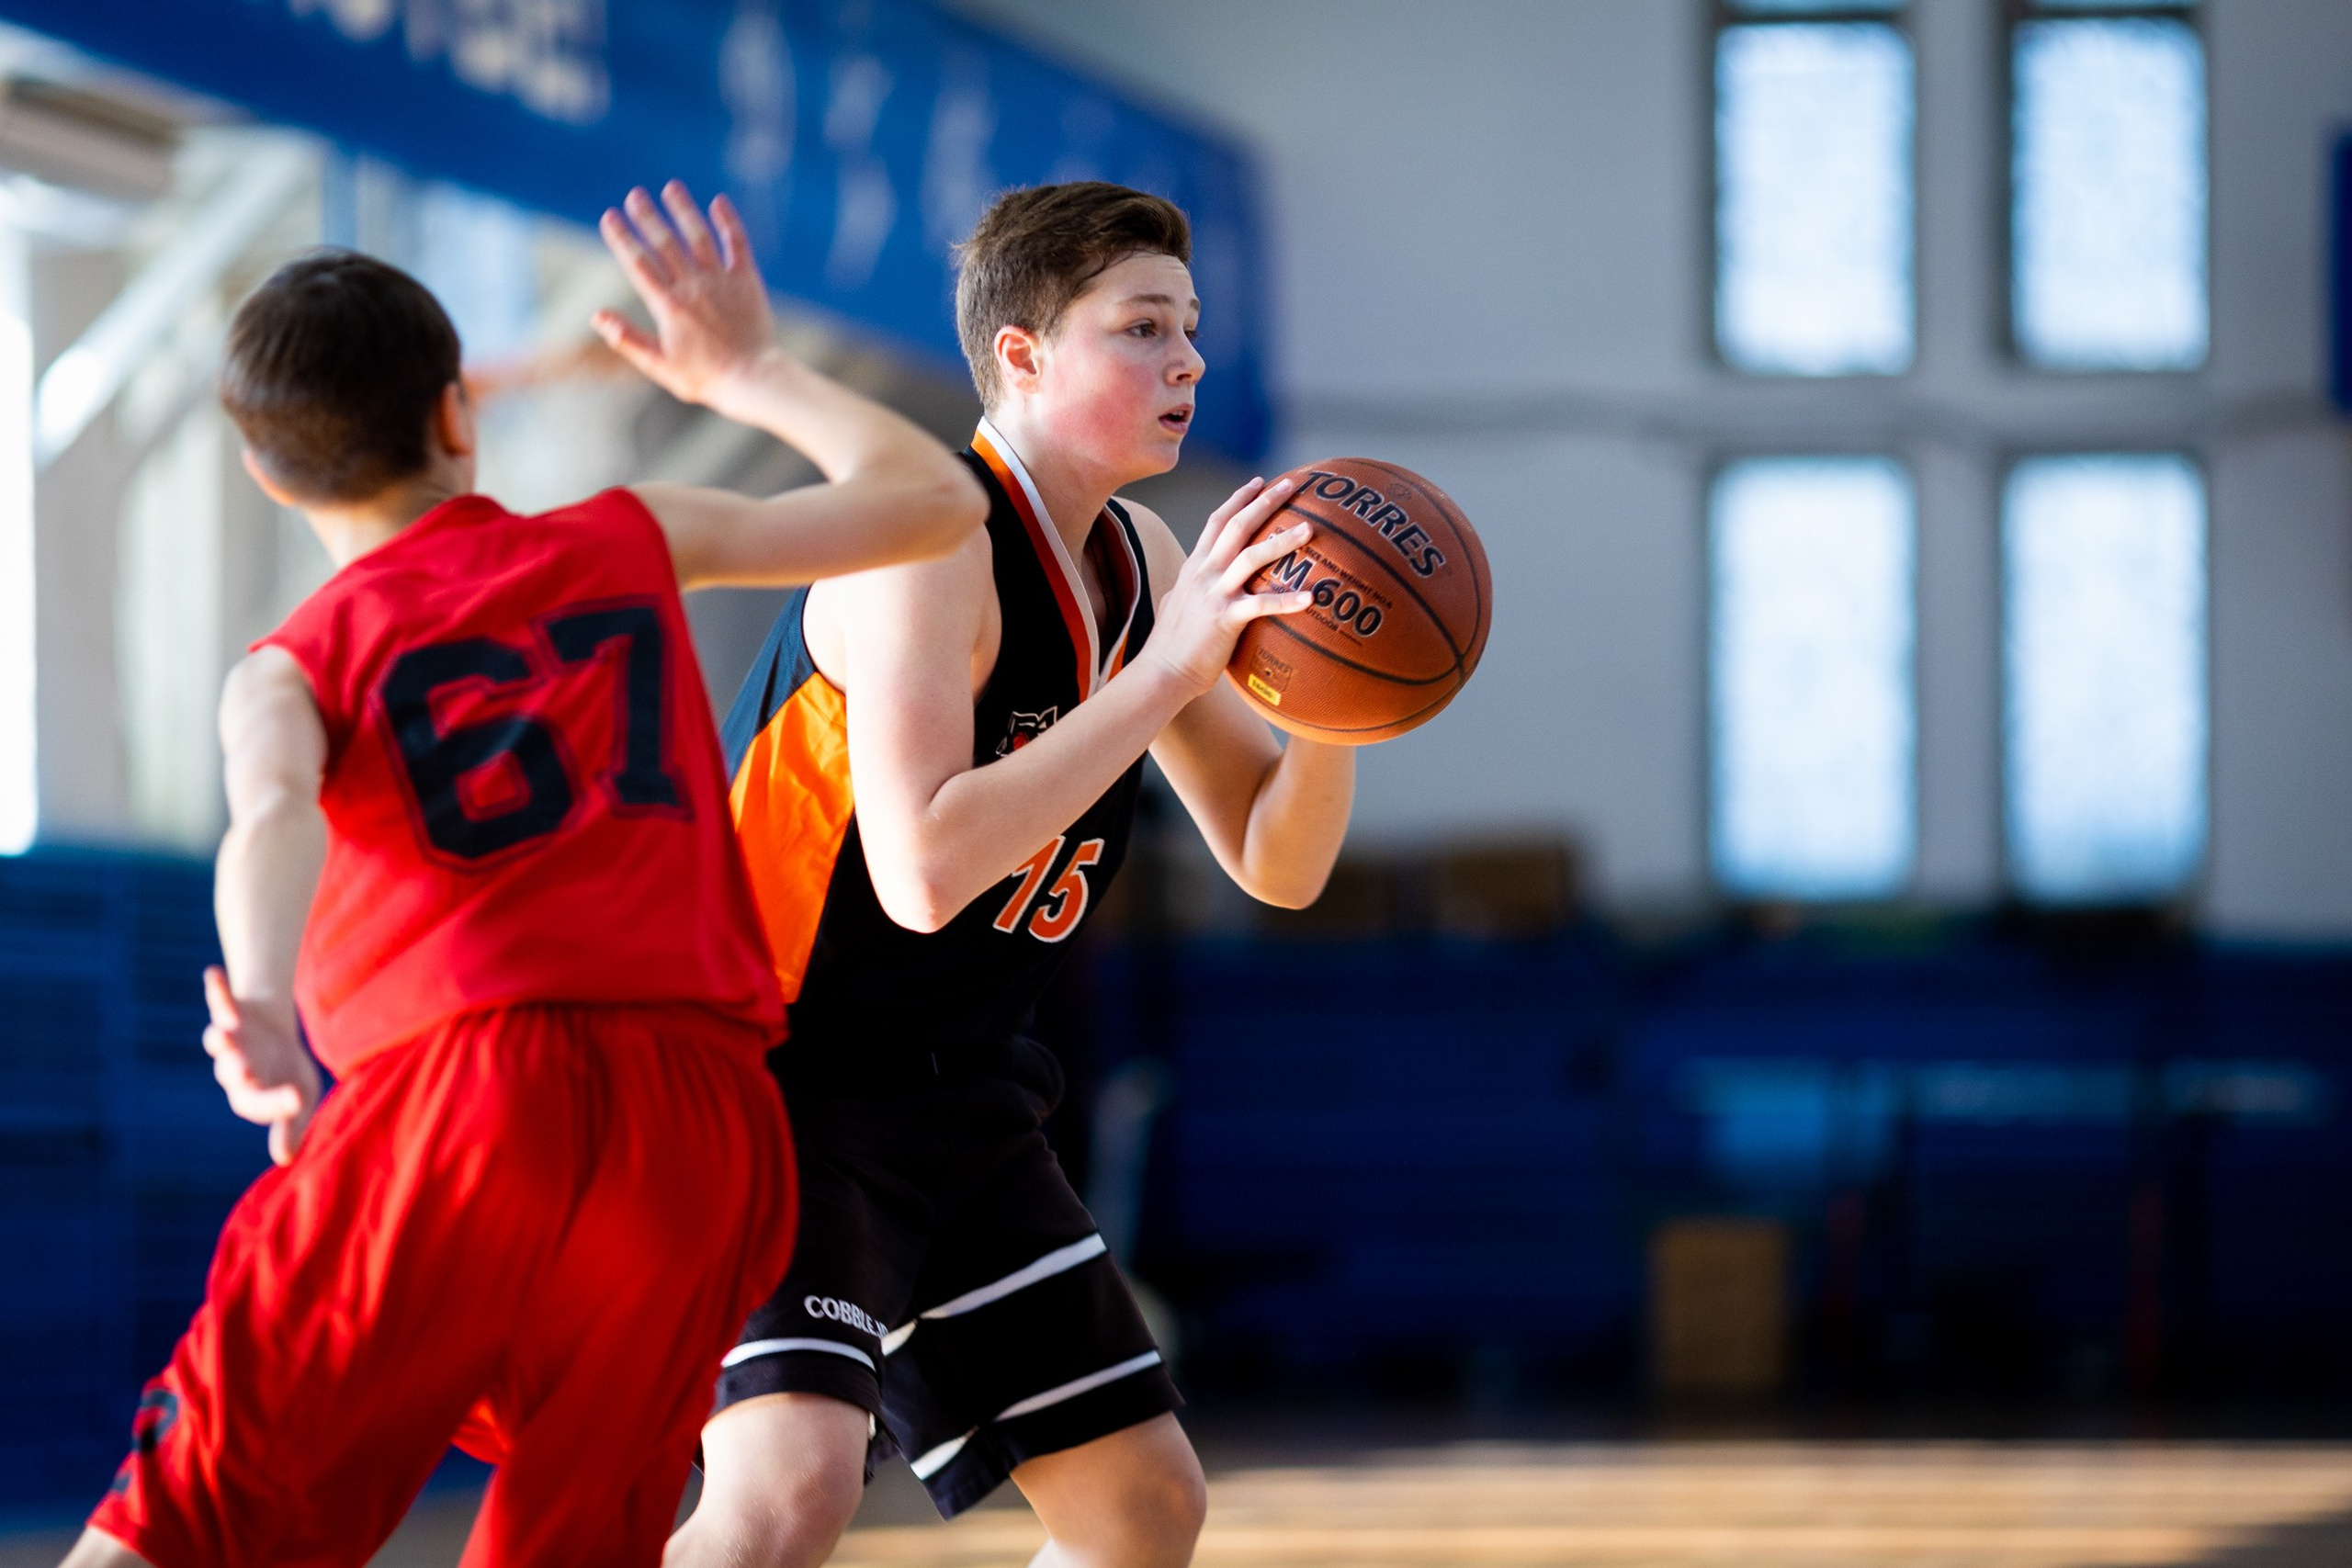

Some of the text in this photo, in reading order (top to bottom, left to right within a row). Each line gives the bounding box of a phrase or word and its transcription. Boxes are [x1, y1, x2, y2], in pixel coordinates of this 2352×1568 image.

[1296, 470, 1446, 579] TORRES
[1269, 534, 1385, 638] M 600
[371, 592, 696, 874] 67
[992, 834, 1105, 942] 15
